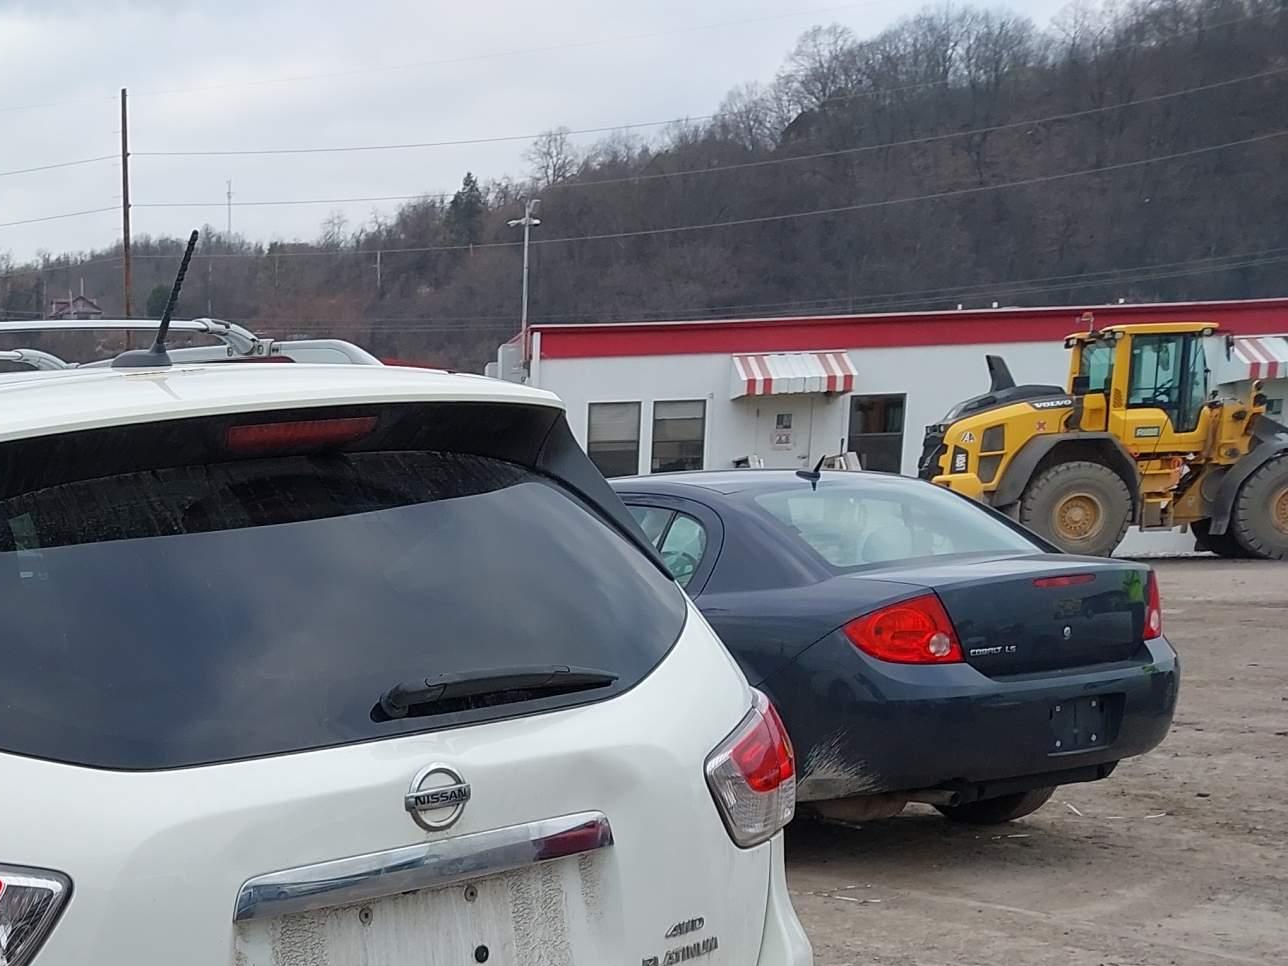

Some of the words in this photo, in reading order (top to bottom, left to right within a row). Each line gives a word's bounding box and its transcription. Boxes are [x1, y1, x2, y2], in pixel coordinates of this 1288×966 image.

[1033, 400, 1072, 408] VOLVO
[1005, 645, 1017, 653] LS
[414, 787, 467, 806] NISSAN
